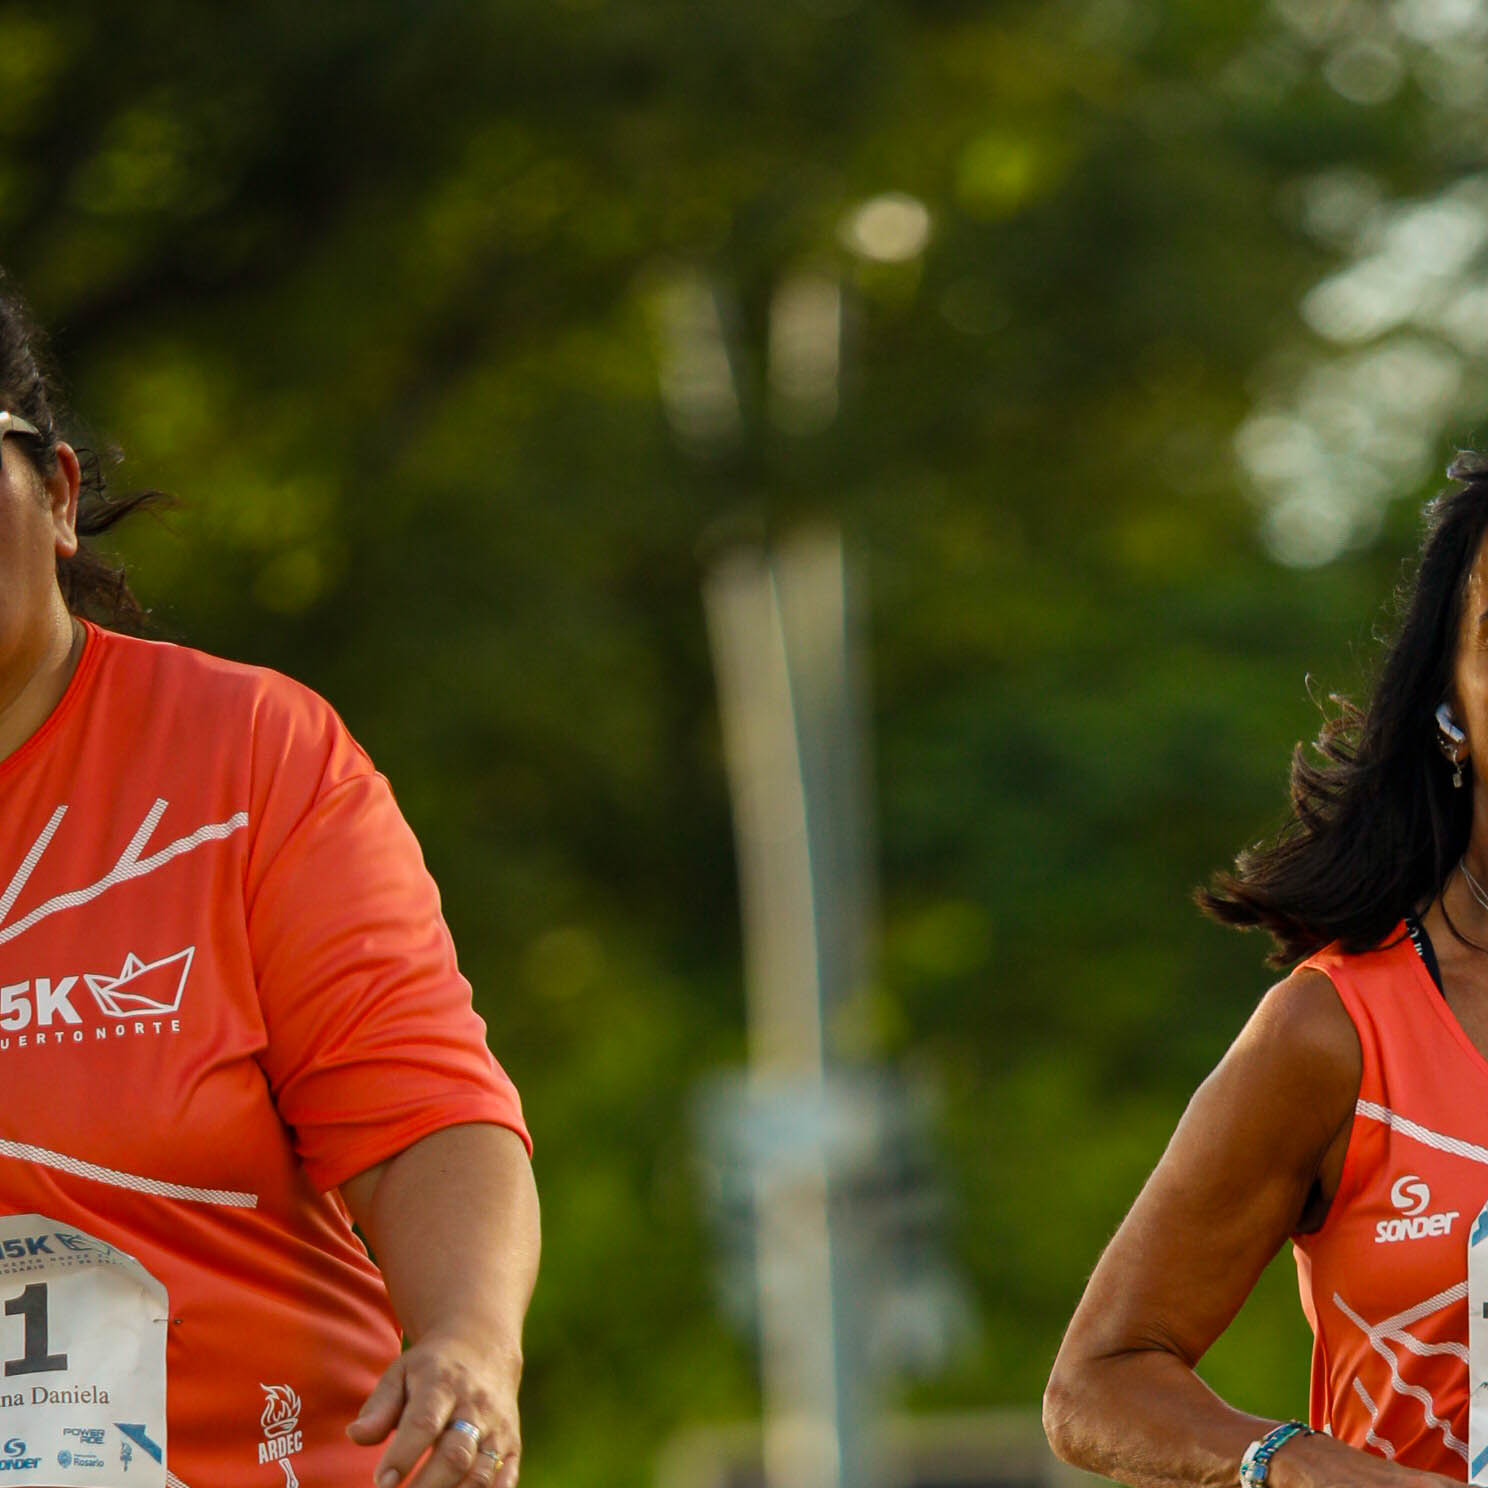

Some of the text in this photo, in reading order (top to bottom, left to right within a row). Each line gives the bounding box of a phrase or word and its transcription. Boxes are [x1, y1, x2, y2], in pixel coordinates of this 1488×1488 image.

[0, 976, 83, 1031] 5K
[0, 1020, 180, 1050] UERTO NORTE
[0, 1385, 110, 1408] na Daniela
[258, 1430, 303, 1464] ARDEC
[73, 1457, 105, 1468] Rosario
